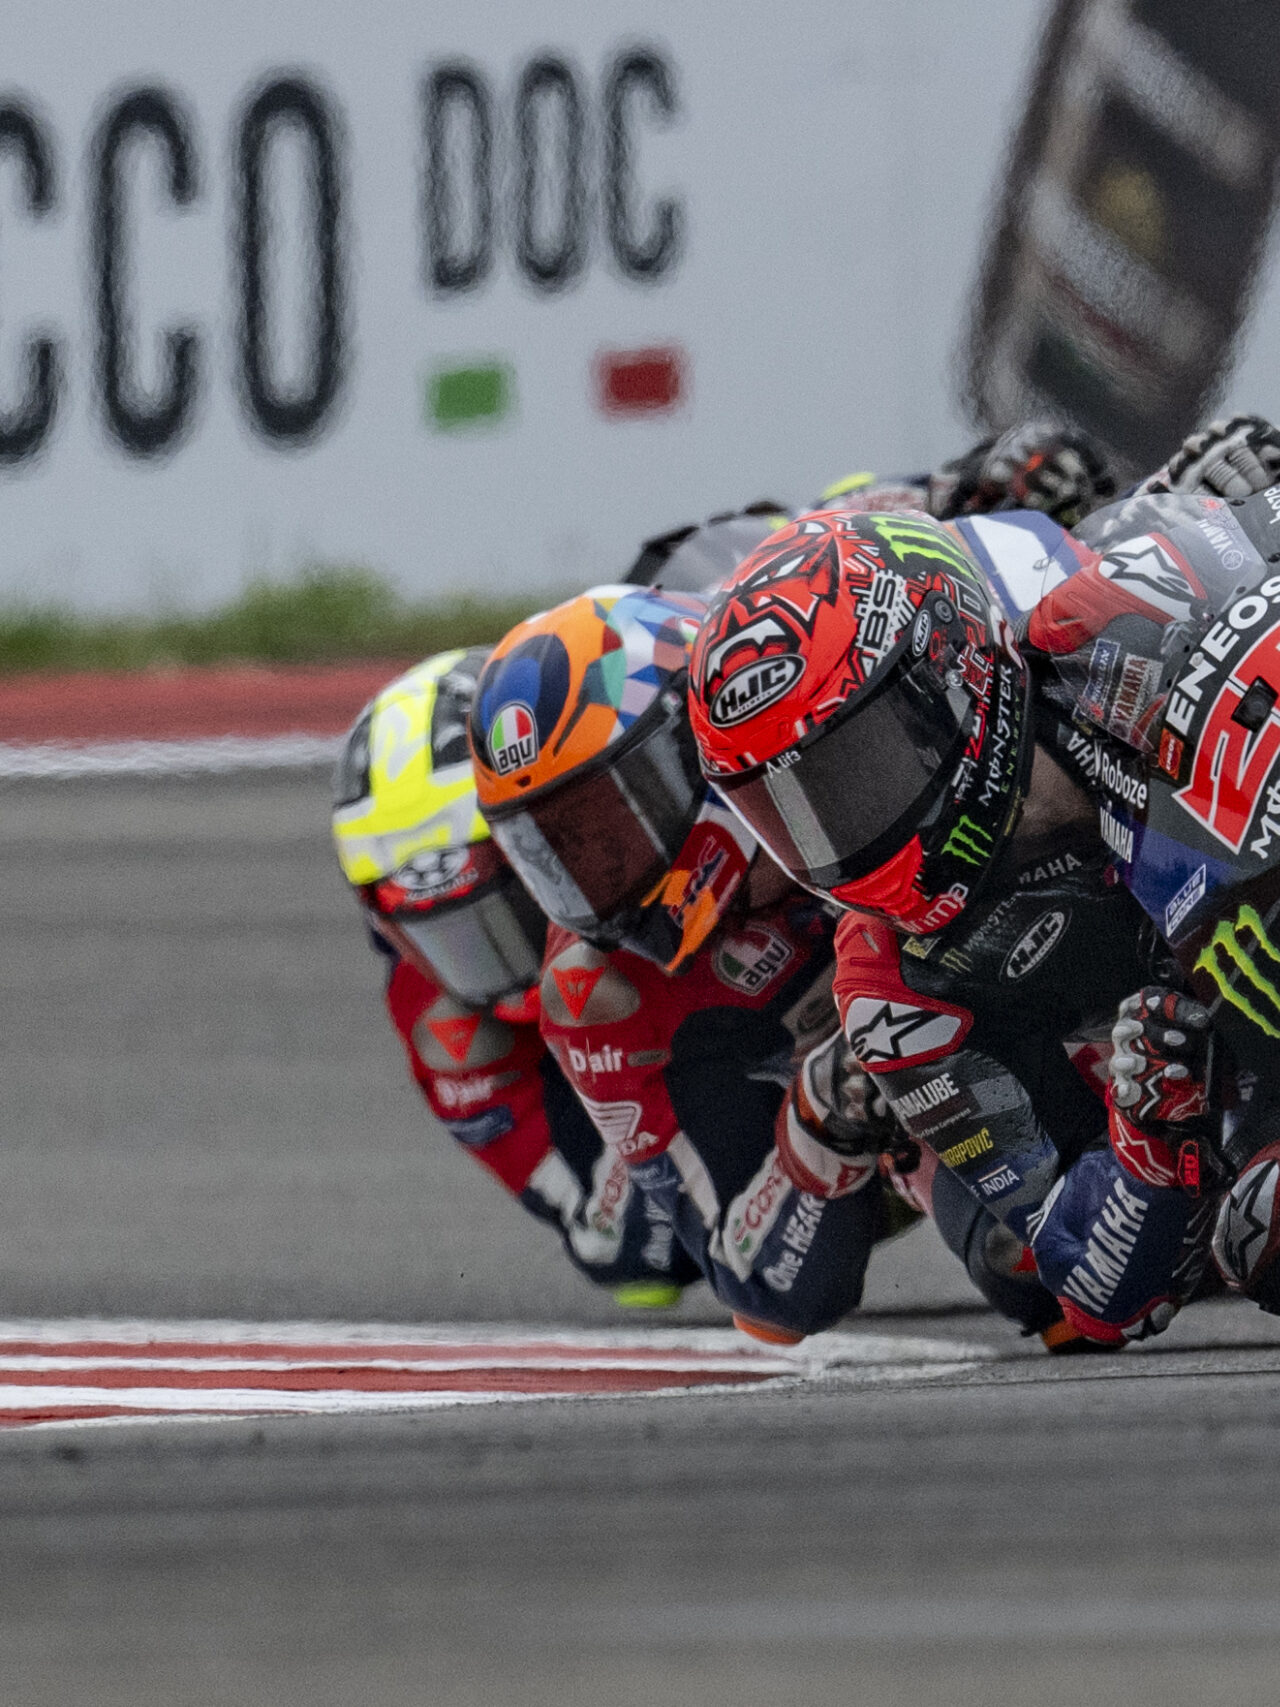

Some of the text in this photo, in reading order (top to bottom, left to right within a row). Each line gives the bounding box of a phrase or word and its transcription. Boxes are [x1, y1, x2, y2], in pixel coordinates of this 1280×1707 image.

[421, 48, 687, 298] DOC
[914, 614, 930, 652] HJC
[719, 660, 790, 719] HJC
[979, 662, 1013, 807] MONSTER
[1102, 751, 1147, 809] Roboze
[1100, 805, 1135, 864] YAMAHA
[1009, 914, 1062, 974] HJC
[982, 1169, 1020, 1197] INDIA
[762, 1191, 827, 1293] One HEAR
[1062, 1177, 1149, 1314] YAMAHA
